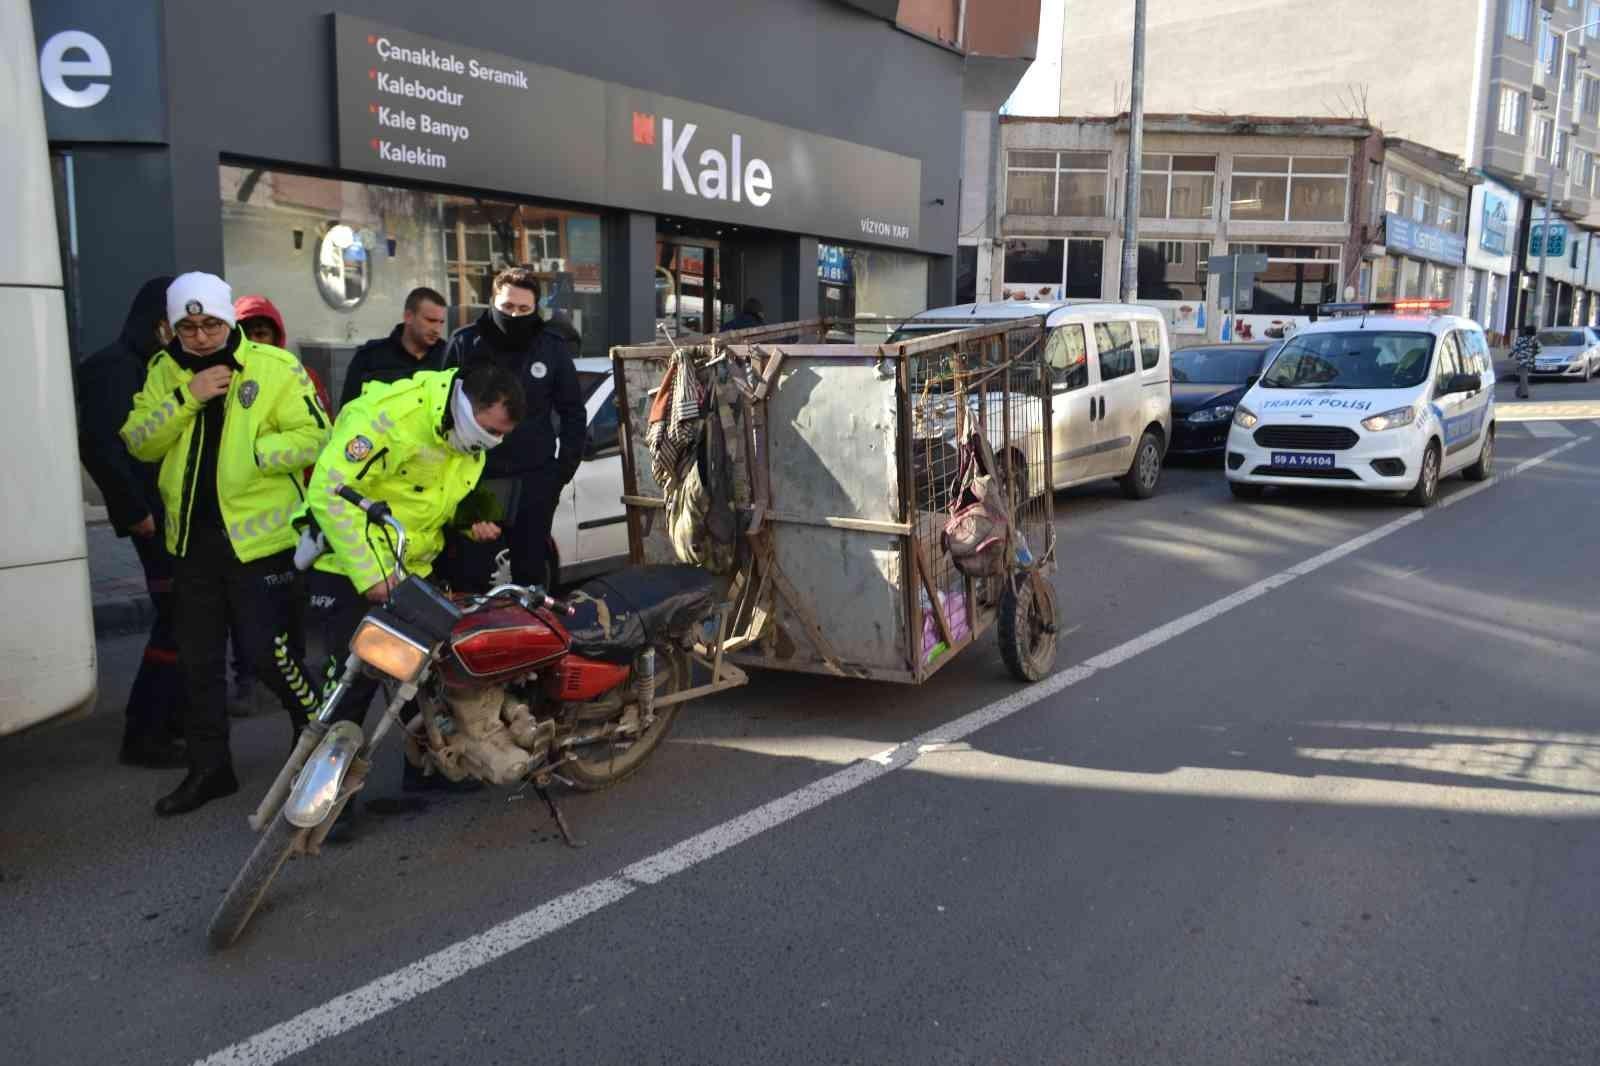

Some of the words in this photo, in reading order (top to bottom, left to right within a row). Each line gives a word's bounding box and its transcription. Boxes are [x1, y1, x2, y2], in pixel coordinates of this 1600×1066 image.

[376, 38, 465, 74] Çanakkale
[468, 59, 528, 89] Seramik
[377, 71, 464, 106] Kalebodur
[378, 105, 416, 130] Kale
[420, 113, 470, 142] Banyo
[379, 140, 447, 168] Kalekim
[661, 117, 773, 207] Kale
[1289, 455, 1297, 465] A
